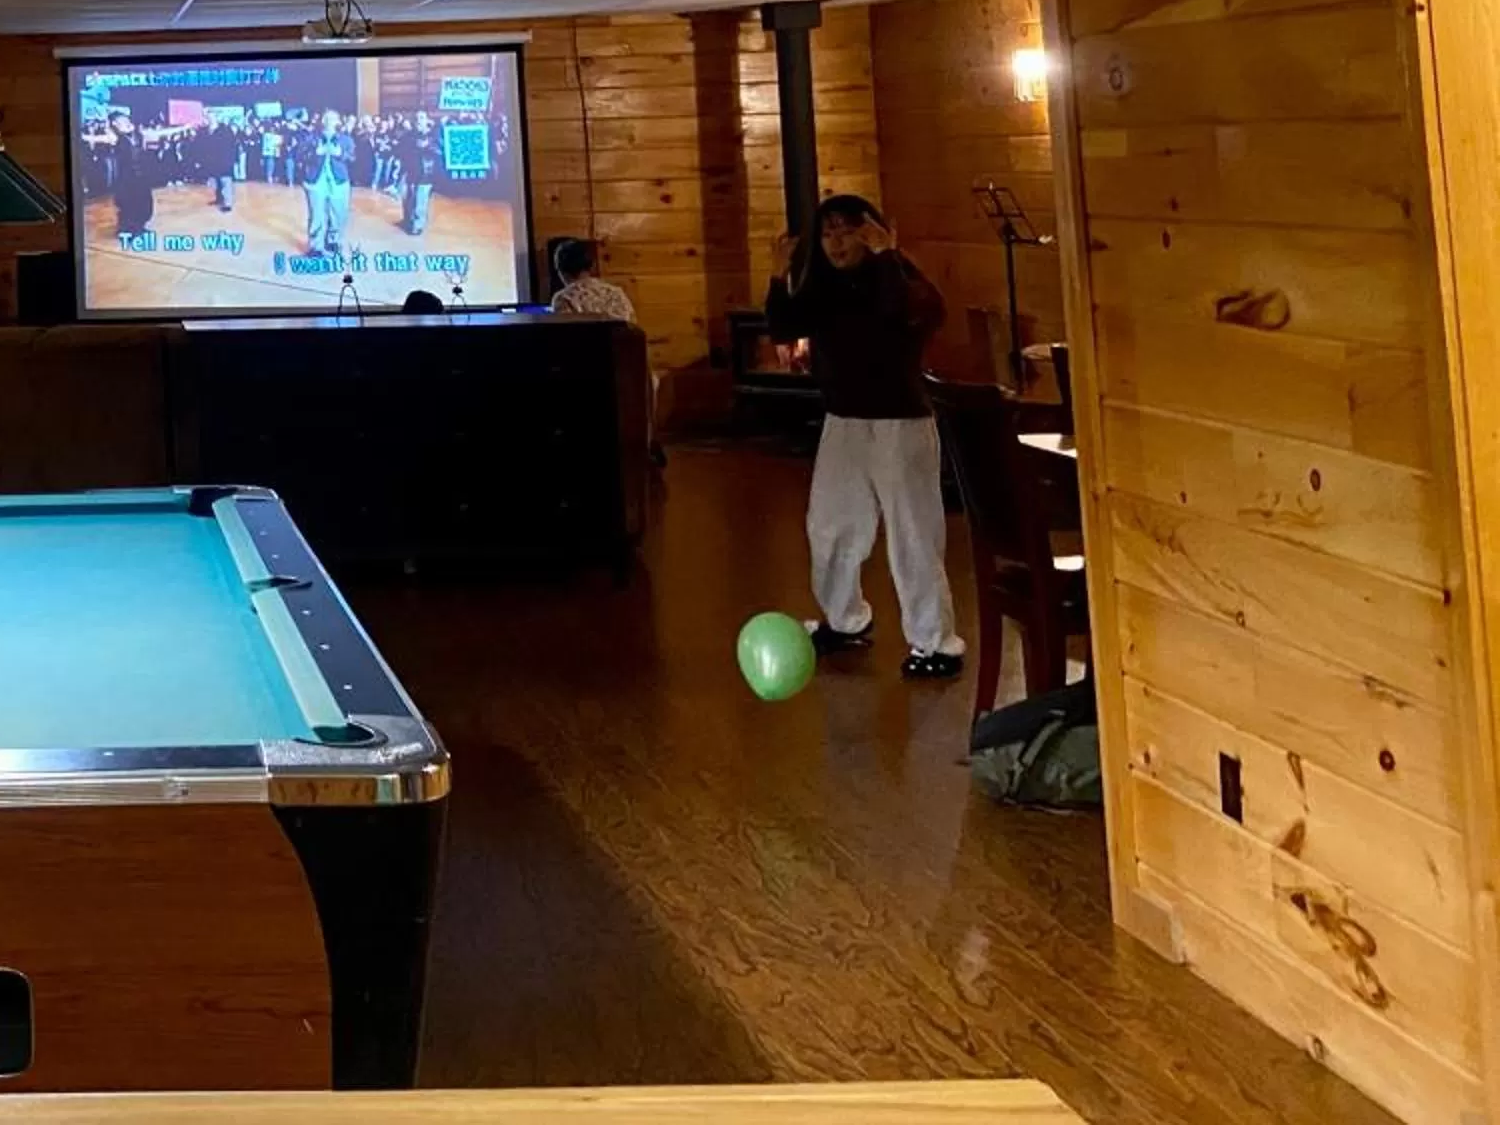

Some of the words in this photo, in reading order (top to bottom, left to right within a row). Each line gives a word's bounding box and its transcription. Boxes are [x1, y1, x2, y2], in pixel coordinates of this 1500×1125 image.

[118, 231, 157, 251] Tell
[164, 235, 194, 251] me
[202, 231, 244, 255] why
[289, 253, 343, 273] want
[351, 251, 367, 272] it
[375, 251, 418, 272] that
[426, 254, 470, 275] way
